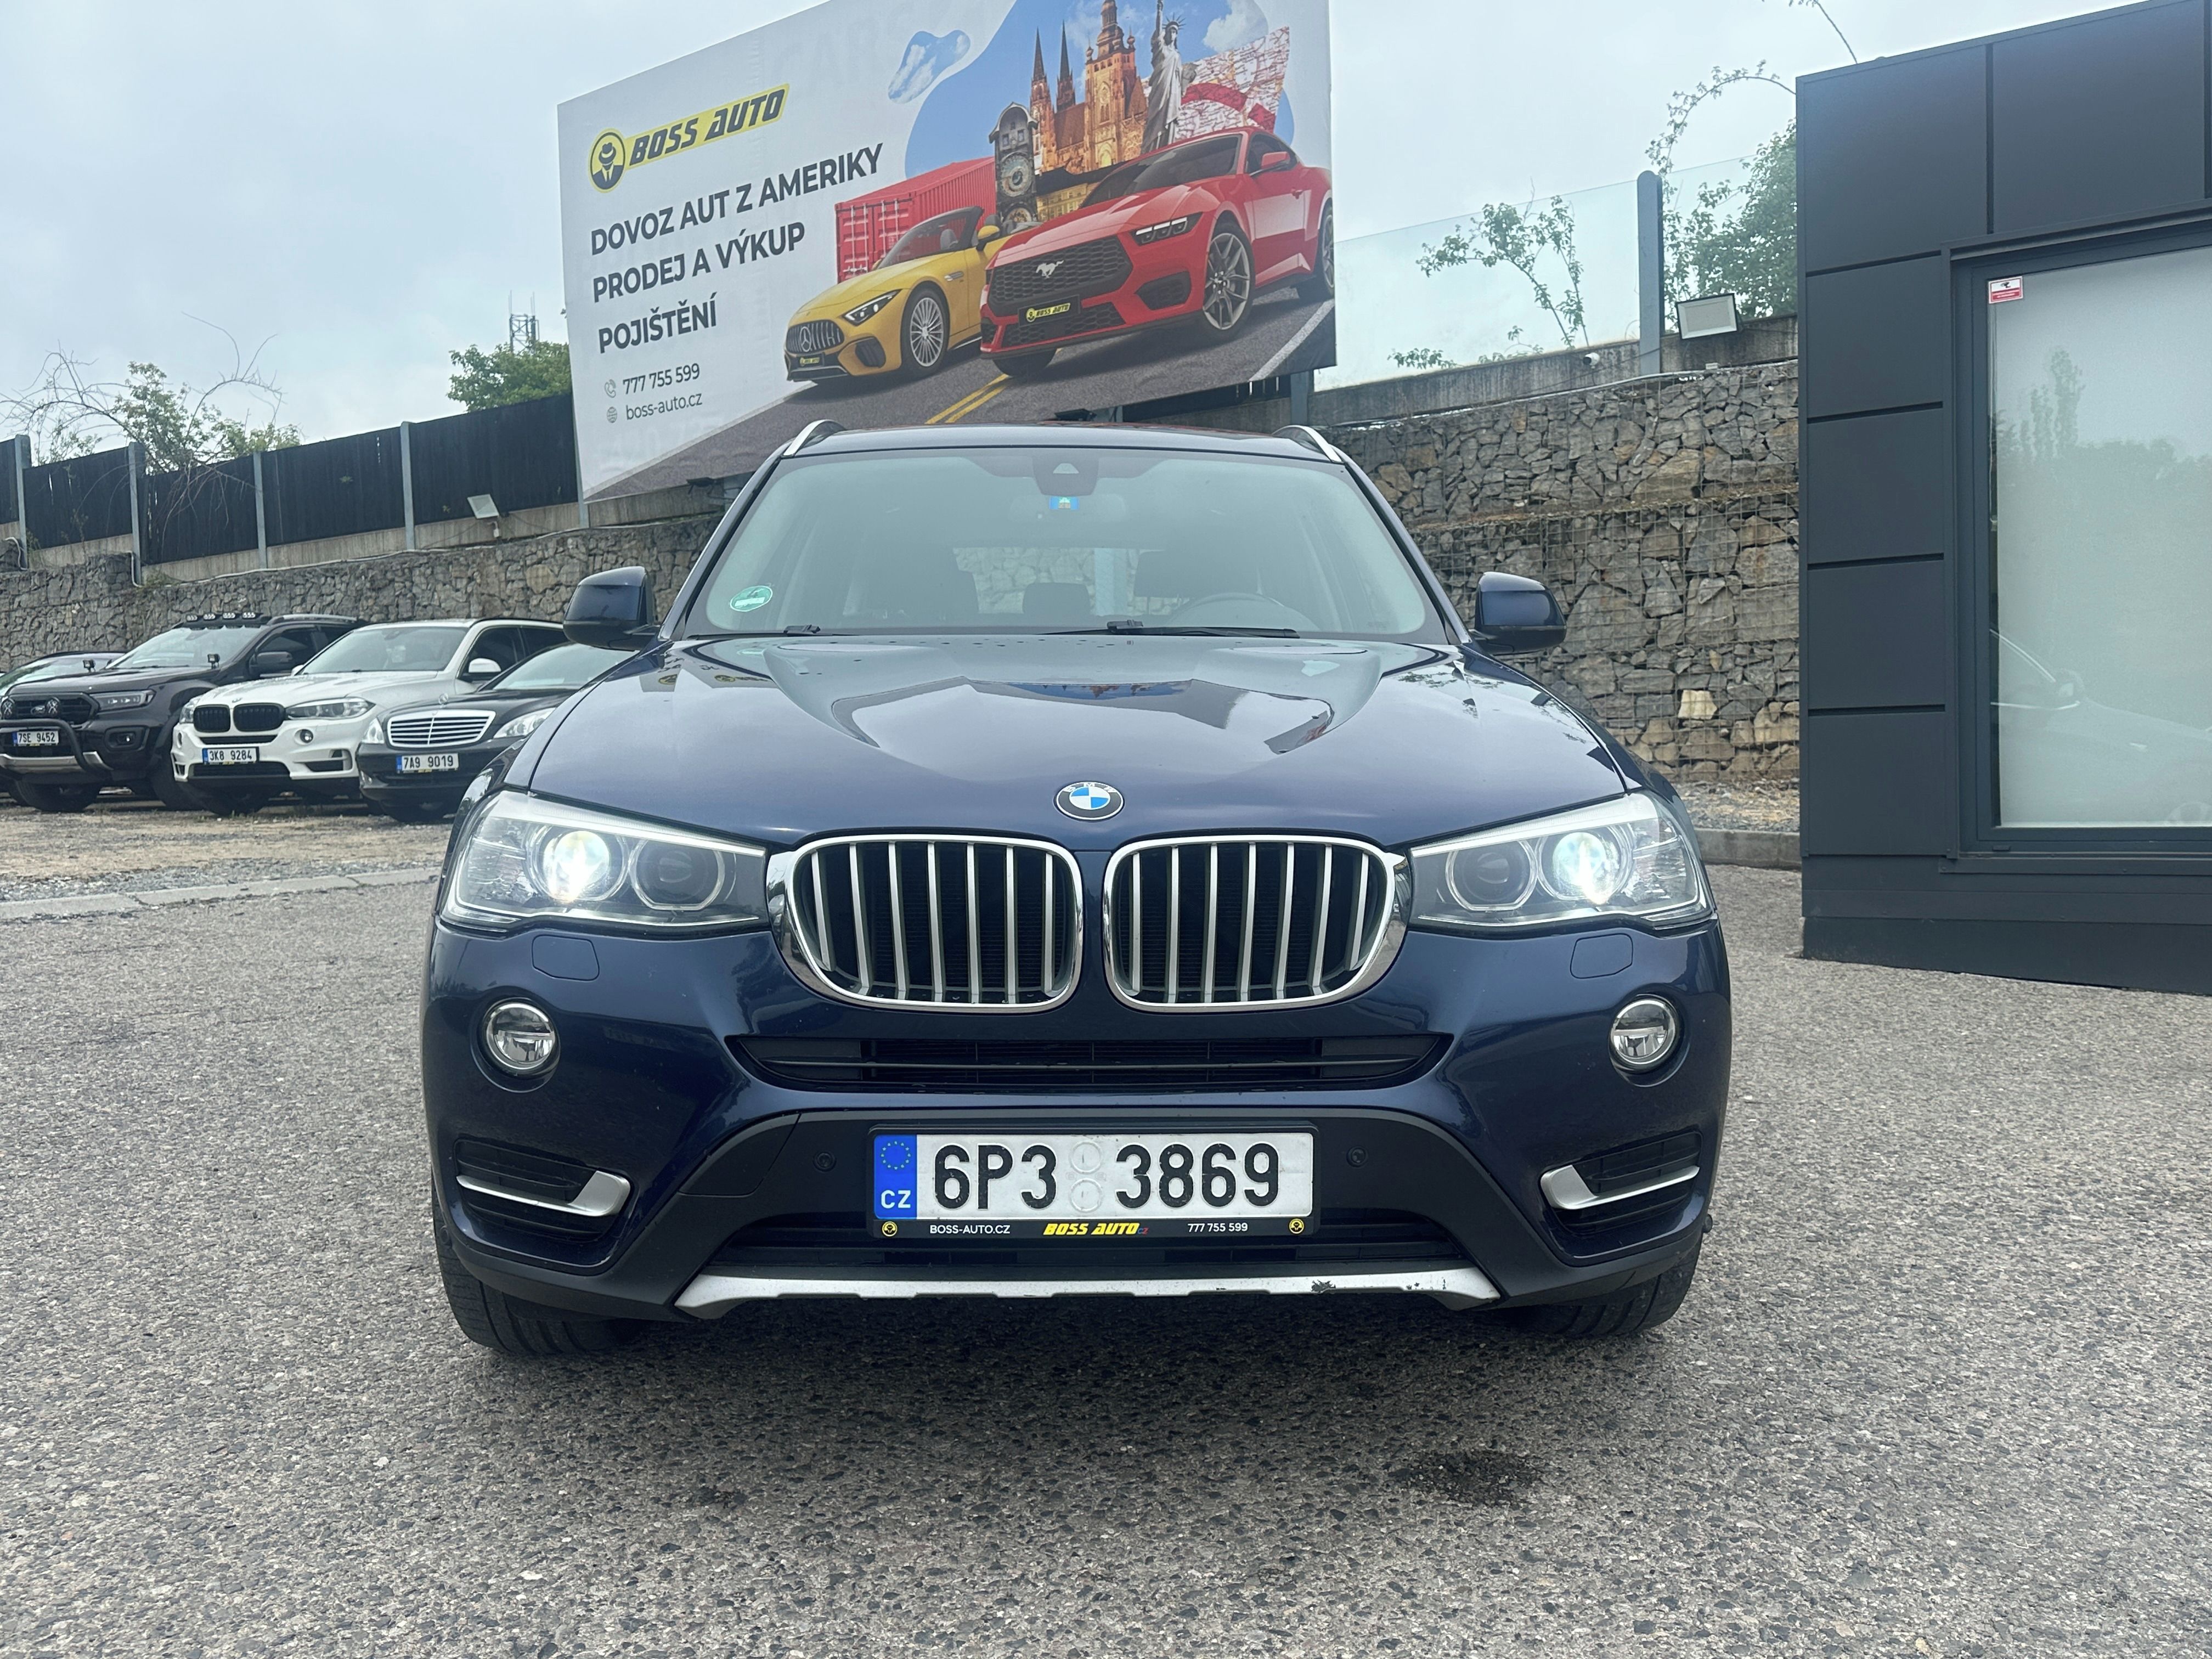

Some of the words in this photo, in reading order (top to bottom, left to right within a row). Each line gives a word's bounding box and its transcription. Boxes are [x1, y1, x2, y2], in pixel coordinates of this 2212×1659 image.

[629, 117, 699, 166] BOSS
[704, 89, 785, 141] AUTO
[591, 207, 674, 255] DOVOZ
[680, 190, 730, 230] AUT
[736, 183, 753, 213] Z
[759, 143, 883, 207] AMERIKY
[593, 253, 685, 303] PRODEJ
[692, 249, 711, 277] A
[715, 222, 805, 269] VÝKUP
[599, 292, 718, 354] POJIŠTĚNÍ
[623, 375, 646, 394] 777
[649, 369, 673, 389] 755
[675, 363, 700, 383] 599
[626, 393, 703, 420] boss-auto.cz
[18, 733, 32, 743] 7SE
[36, 732, 56, 742] 9452
[210, 750, 224, 760] 3K8
[230, 750, 252, 760] 9284
[403, 757, 420, 769] 7A9
[428, 755, 453, 767] 9019
[934, 1143, 1057, 1210] 6P3
[1116, 1143, 1279, 1209] 3869
[881, 1189, 911, 1209] CZ
[929, 1224, 1011, 1234] BOSS-AUTO.CZ
[1043, 1223, 1089, 1235] BOSS
[1091, 1222, 1140, 1235] AUTO
[1187, 1223, 1205, 1233] 777
[1207, 1223, 1226, 1232] 755
[1228, 1222, 1248, 1232] 599
